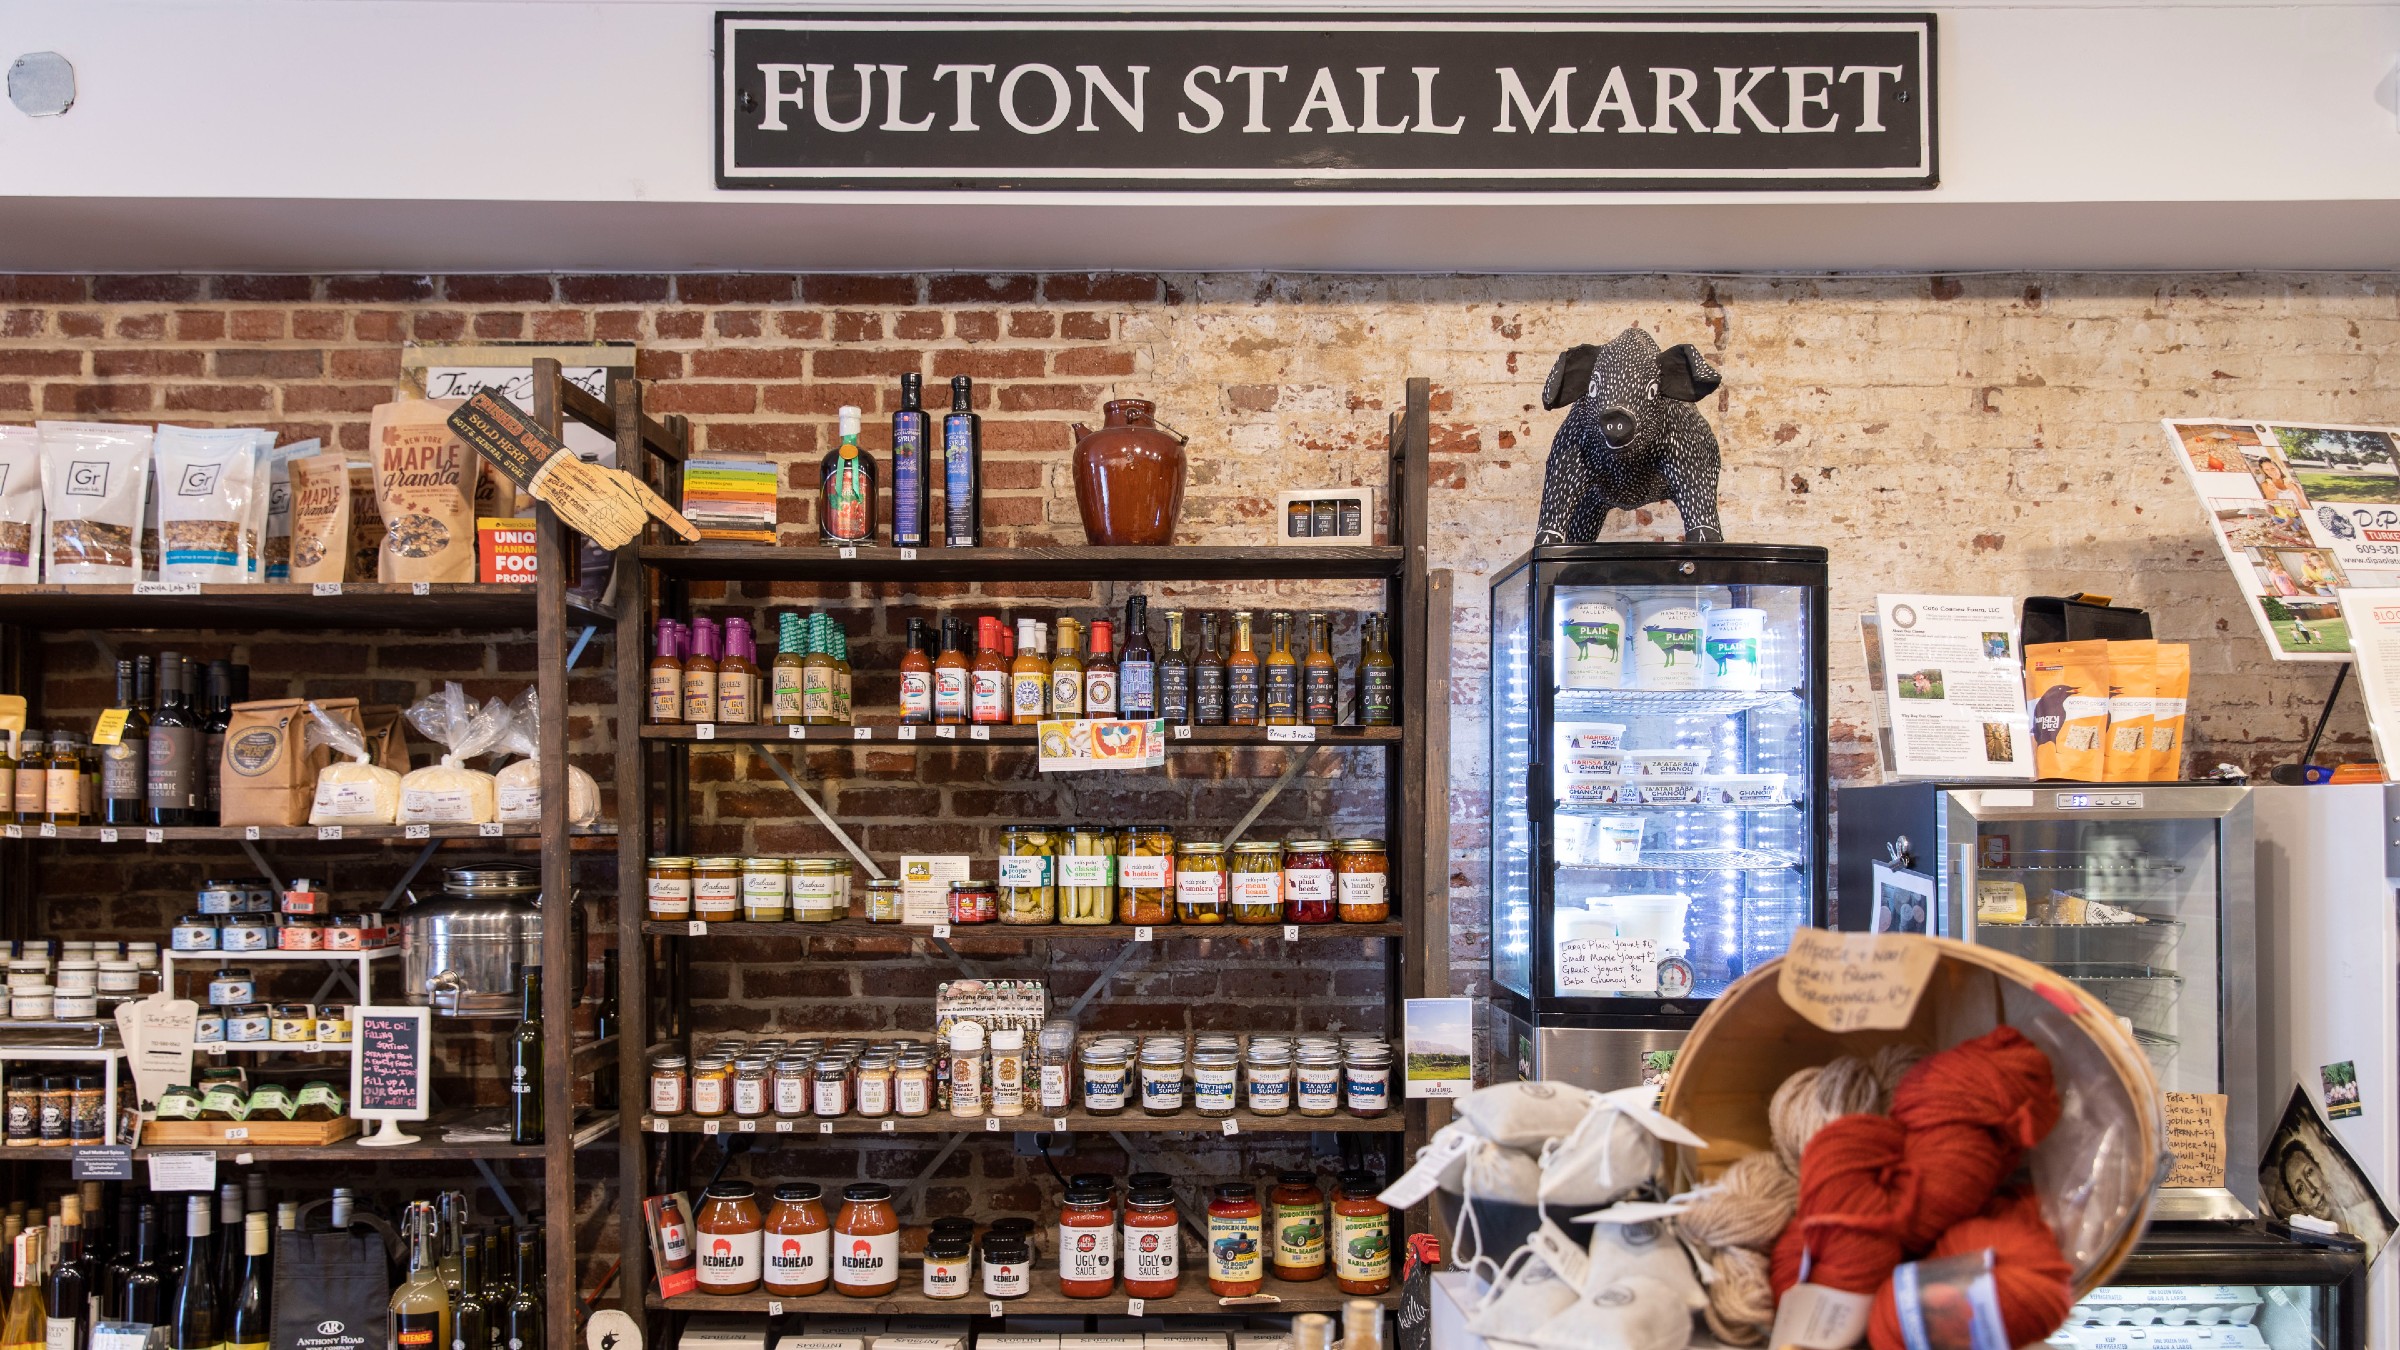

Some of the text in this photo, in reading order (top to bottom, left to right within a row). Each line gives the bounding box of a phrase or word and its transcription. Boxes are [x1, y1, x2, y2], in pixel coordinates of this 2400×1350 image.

[757, 62, 1904, 137] FULTON STALL MARKET
[470, 393, 525, 437] CRUSHED
[520, 431, 553, 463] OATS
[403, 435, 442, 446] NEW YORK
[468, 413, 501, 441] SOLD
[496, 436, 530, 466] HERE
[897, 435, 917, 443] SYRUP
[383, 444, 461, 472] MAPLE
[74, 468, 101, 486] Gr
[188, 472, 213, 488] Gr
[382, 459, 461, 502] granola
[299, 485, 341, 507] MAPLE
[558, 488, 589, 515] ONE POUND
[296, 502, 340, 521] granola
[2352, 508, 2400, 530] DiP
[494, 531, 538, 544] UNIQ
[904, 550, 913, 559] 18
[495, 555, 538, 571] FOO
[495, 573, 538, 583] PRODU
[315, 584, 340, 594] $4.50
[414, 584, 429, 595] $13
[1580, 627, 1609, 635] PLAIN
[1666, 633, 1694, 641] PLAIN
[1718, 643, 1746, 651] PLAIN
[777, 681, 799, 689] BRONX
[2035, 715, 2060, 724] hungry
[2042, 720, 2059, 730] bird
[904, 728, 910, 737] 9
[976, 729, 983, 737] 6
[1178, 729, 1189, 737] 10
[1579, 764, 1612, 772] GHANOUJ
[1660, 766, 1694, 774] GHANOUJ
[2073, 796, 2088, 806] 39
[1298, 878, 1316, 887] phat
[1351, 882, 1376, 890] handy
[1138, 929, 1146, 938] 8
[1289, 928, 1296, 938] 8
[1561, 939, 1653, 956] Large Plain Yogurt $6
[1561, 952, 1586, 963] Small
[1590, 953, 1617, 964] Maple
[1616, 952, 1646, 966] Yogurt
[1561, 964, 1590, 974] Greek
[1562, 976, 1585, 986] Baba
[363, 1086, 387, 1097] OUR
[2165, 1092, 2185, 1103] Feta
[656, 1122, 666, 1131] 10
[706, 1123, 717, 1133] 10
[989, 1120, 996, 1129] 8
[230, 1129, 242, 1137] 30
[2164, 1173, 2195, 1186] Butter
[1278, 1211, 1310, 1219] HOBOKEN
[702, 1255, 744, 1268] REDHEAD
[771, 1255, 814, 1268] REDHEAD
[842, 1255, 884, 1268] REDHEAD
[1075, 1254, 1097, 1267] UGLY
[1138, 1254, 1160, 1267] UGLY
[1075, 1266, 1097, 1276] SAUCE
[1138, 1266, 1160, 1276] SAUCE
[930, 1274, 957, 1283] REDHEAD
[992, 1274, 1020, 1283] REDHEAD
[770, 1303, 781, 1314] 15
[990, 1304, 1002, 1313] 12
[322, 1321, 340, 1334] AR
[821, 1326, 867, 1334] SFOGLINI
[296, 1335, 365, 1346] ANTHONY ROAD
